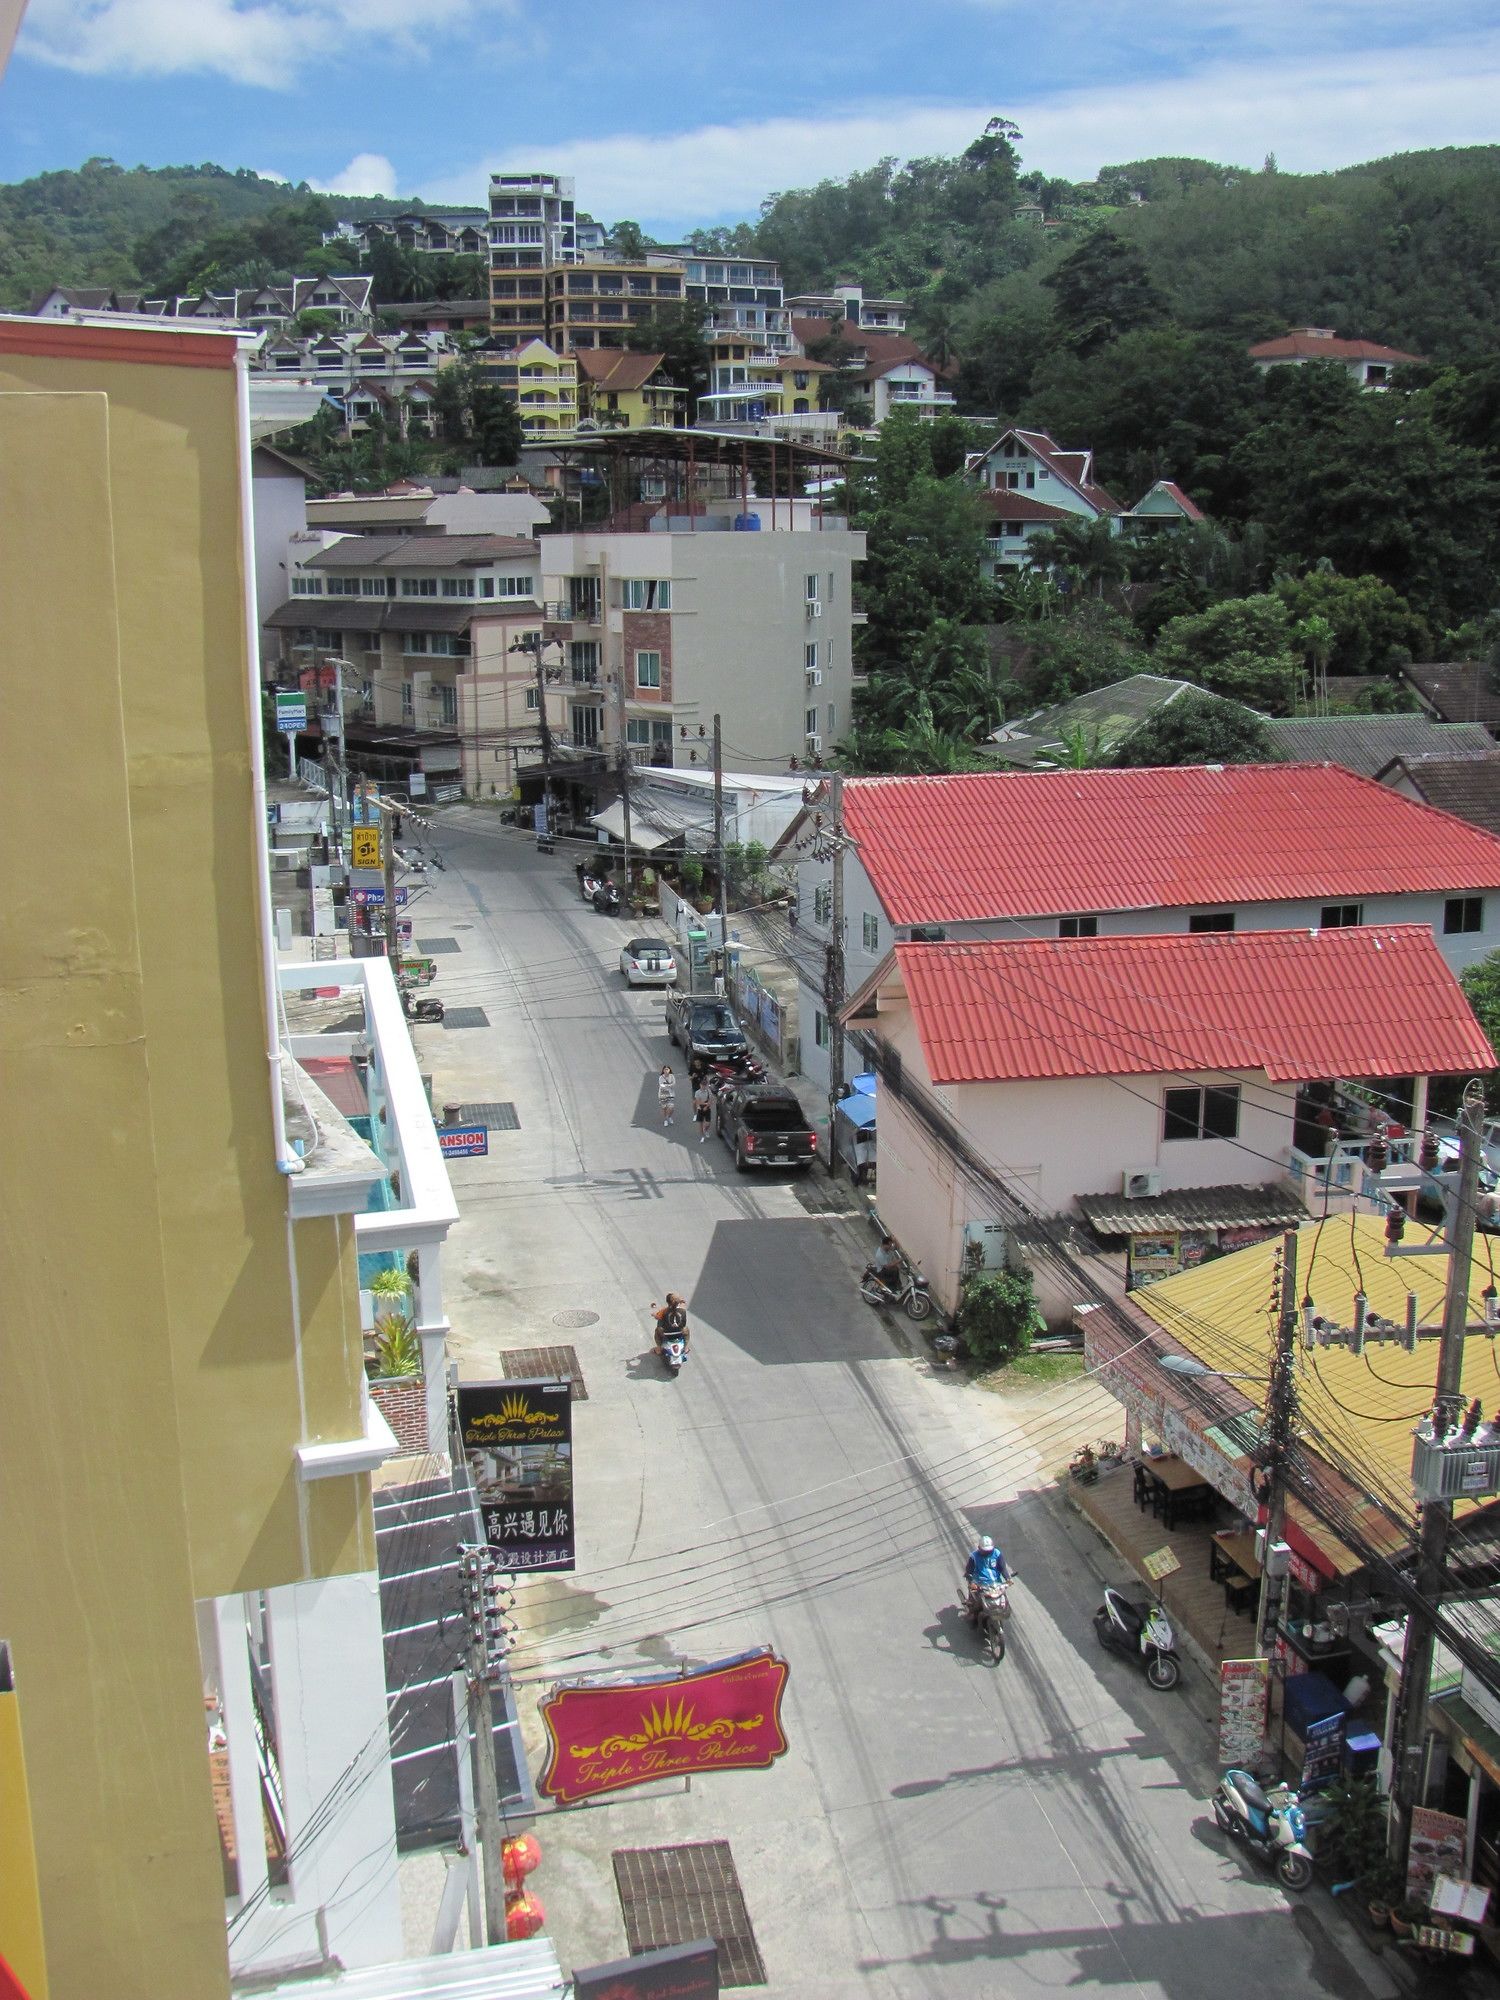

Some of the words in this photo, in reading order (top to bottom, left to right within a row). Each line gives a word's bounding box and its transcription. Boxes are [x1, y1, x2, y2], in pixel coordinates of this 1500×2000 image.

[367, 893, 404, 903] Pharcy
[466, 1429, 497, 1443] Triple
[498, 1427, 526, 1442] Three
[528, 1427, 565, 1440] Palace
[488, 1509, 569, 1539] 高兴遇见你
[576, 1761, 633, 1785] Triple
[639, 1750, 690, 1771] Three
[697, 1741, 758, 1761] Palace
